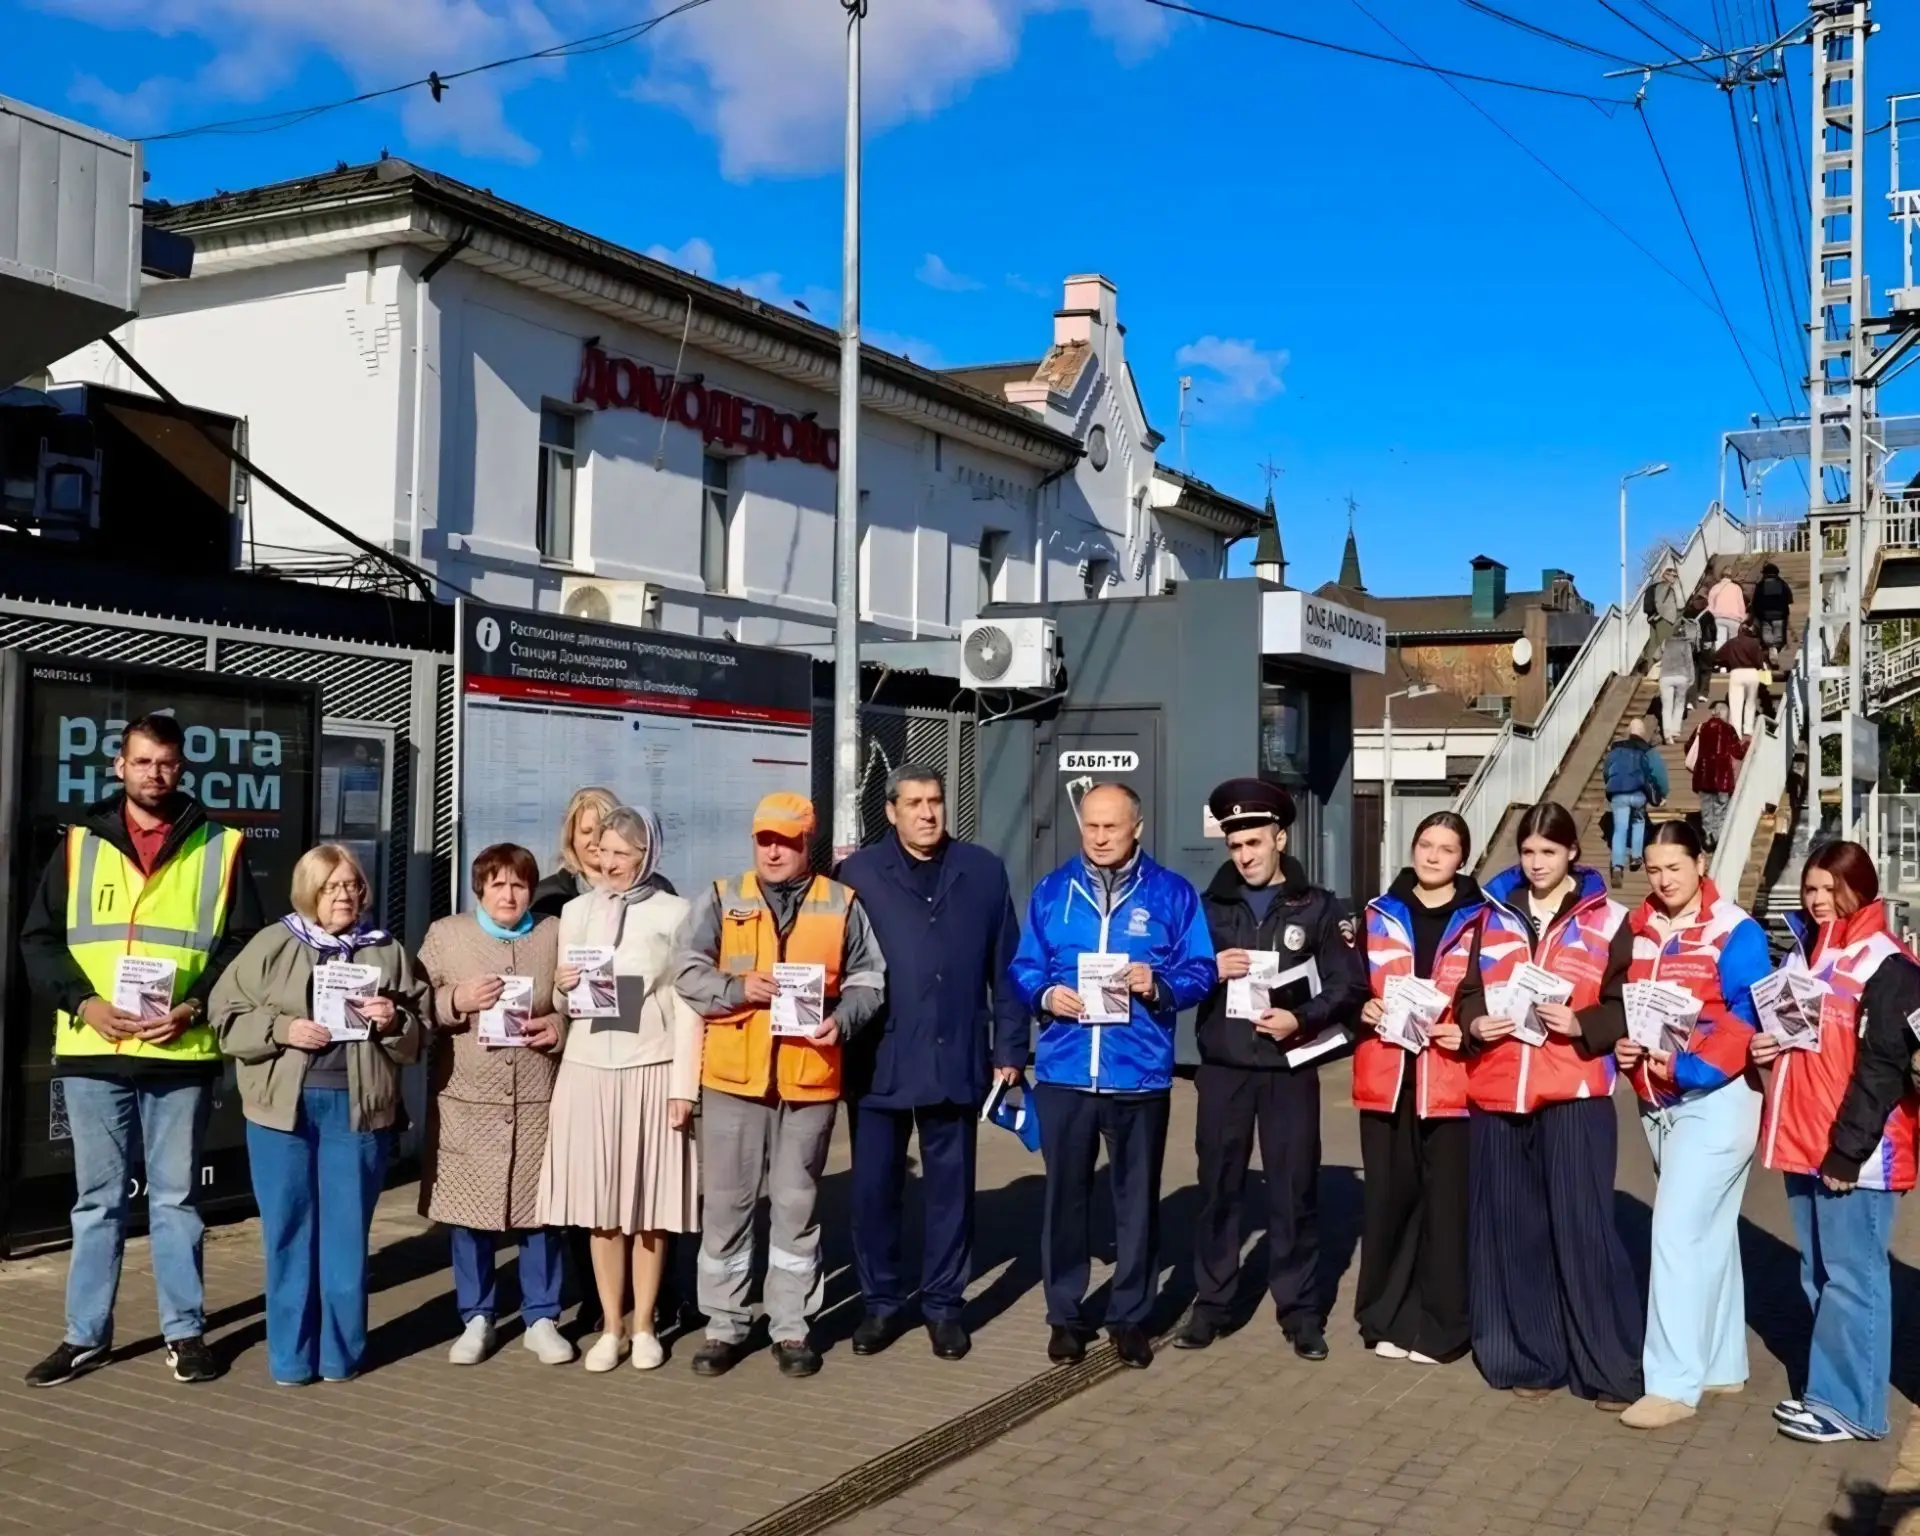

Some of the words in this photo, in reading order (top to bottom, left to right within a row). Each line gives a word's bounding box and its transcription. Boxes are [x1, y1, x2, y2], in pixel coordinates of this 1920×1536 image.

[574, 348, 839, 471] ДОМОДЕДОВО
[509, 620, 576, 643] Расписание
[1307, 604, 1326, 630] ONE
[1327, 610, 1347, 636] AND
[1348, 617, 1382, 646] DOUBLE
[509, 641, 557, 662] Станция
[559, 648, 628, 670] Домодедово
[58, 708, 282, 767] раота
